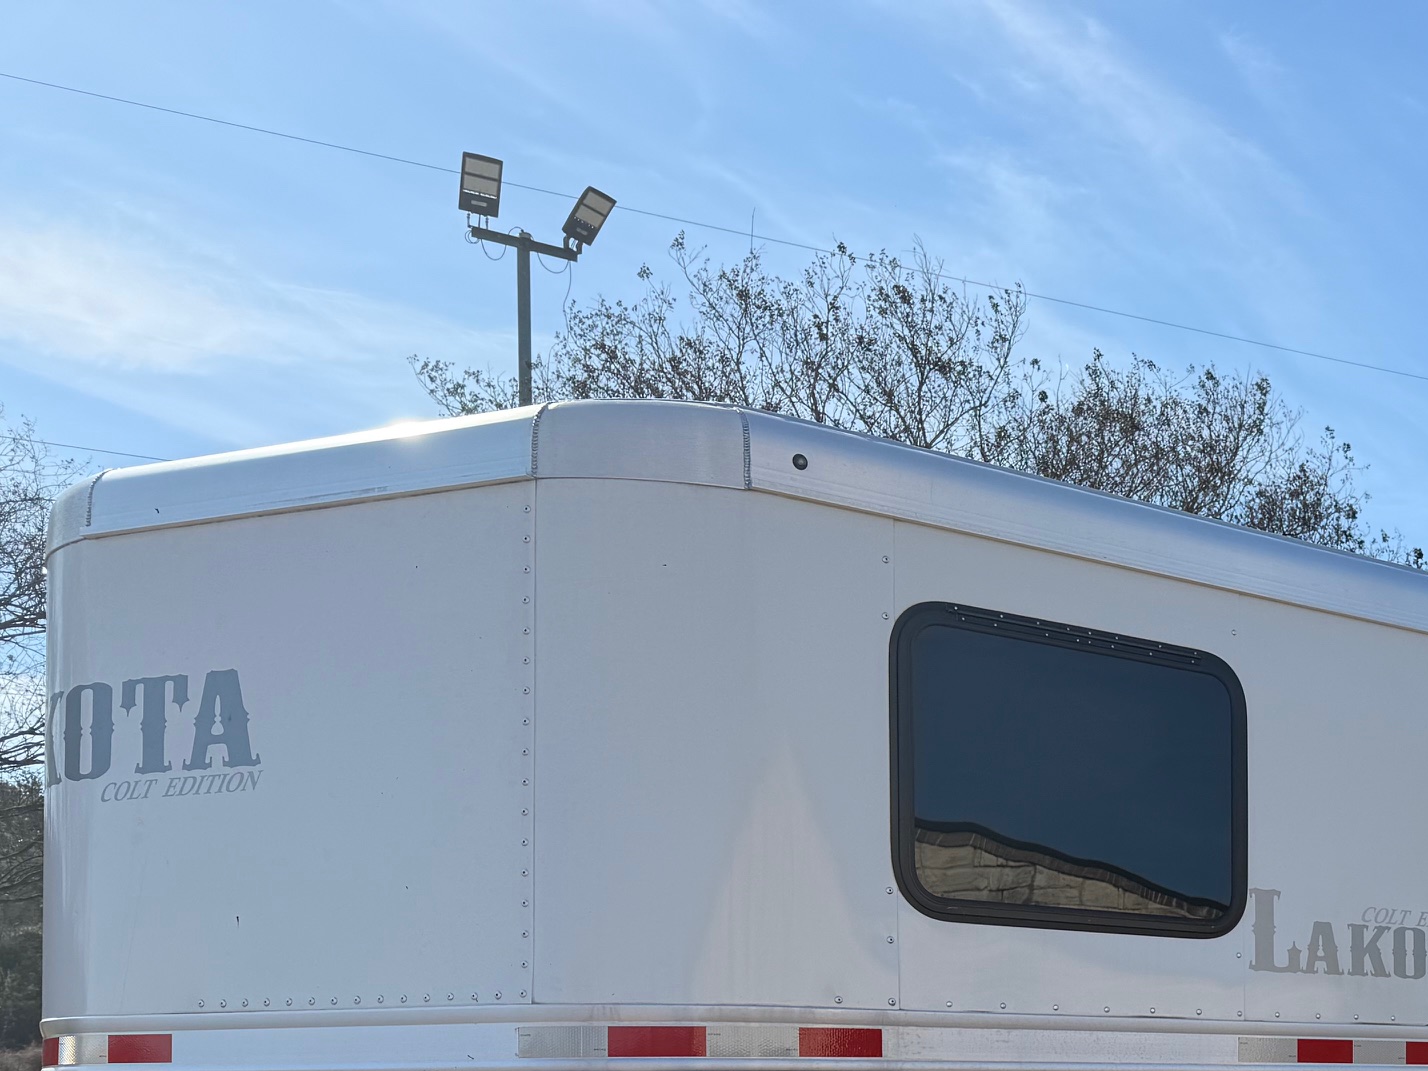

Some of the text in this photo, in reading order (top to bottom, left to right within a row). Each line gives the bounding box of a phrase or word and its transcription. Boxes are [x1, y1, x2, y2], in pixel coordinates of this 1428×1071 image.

[100, 769, 264, 803] COLT EDITION
[1361, 906, 1411, 927] COLT
